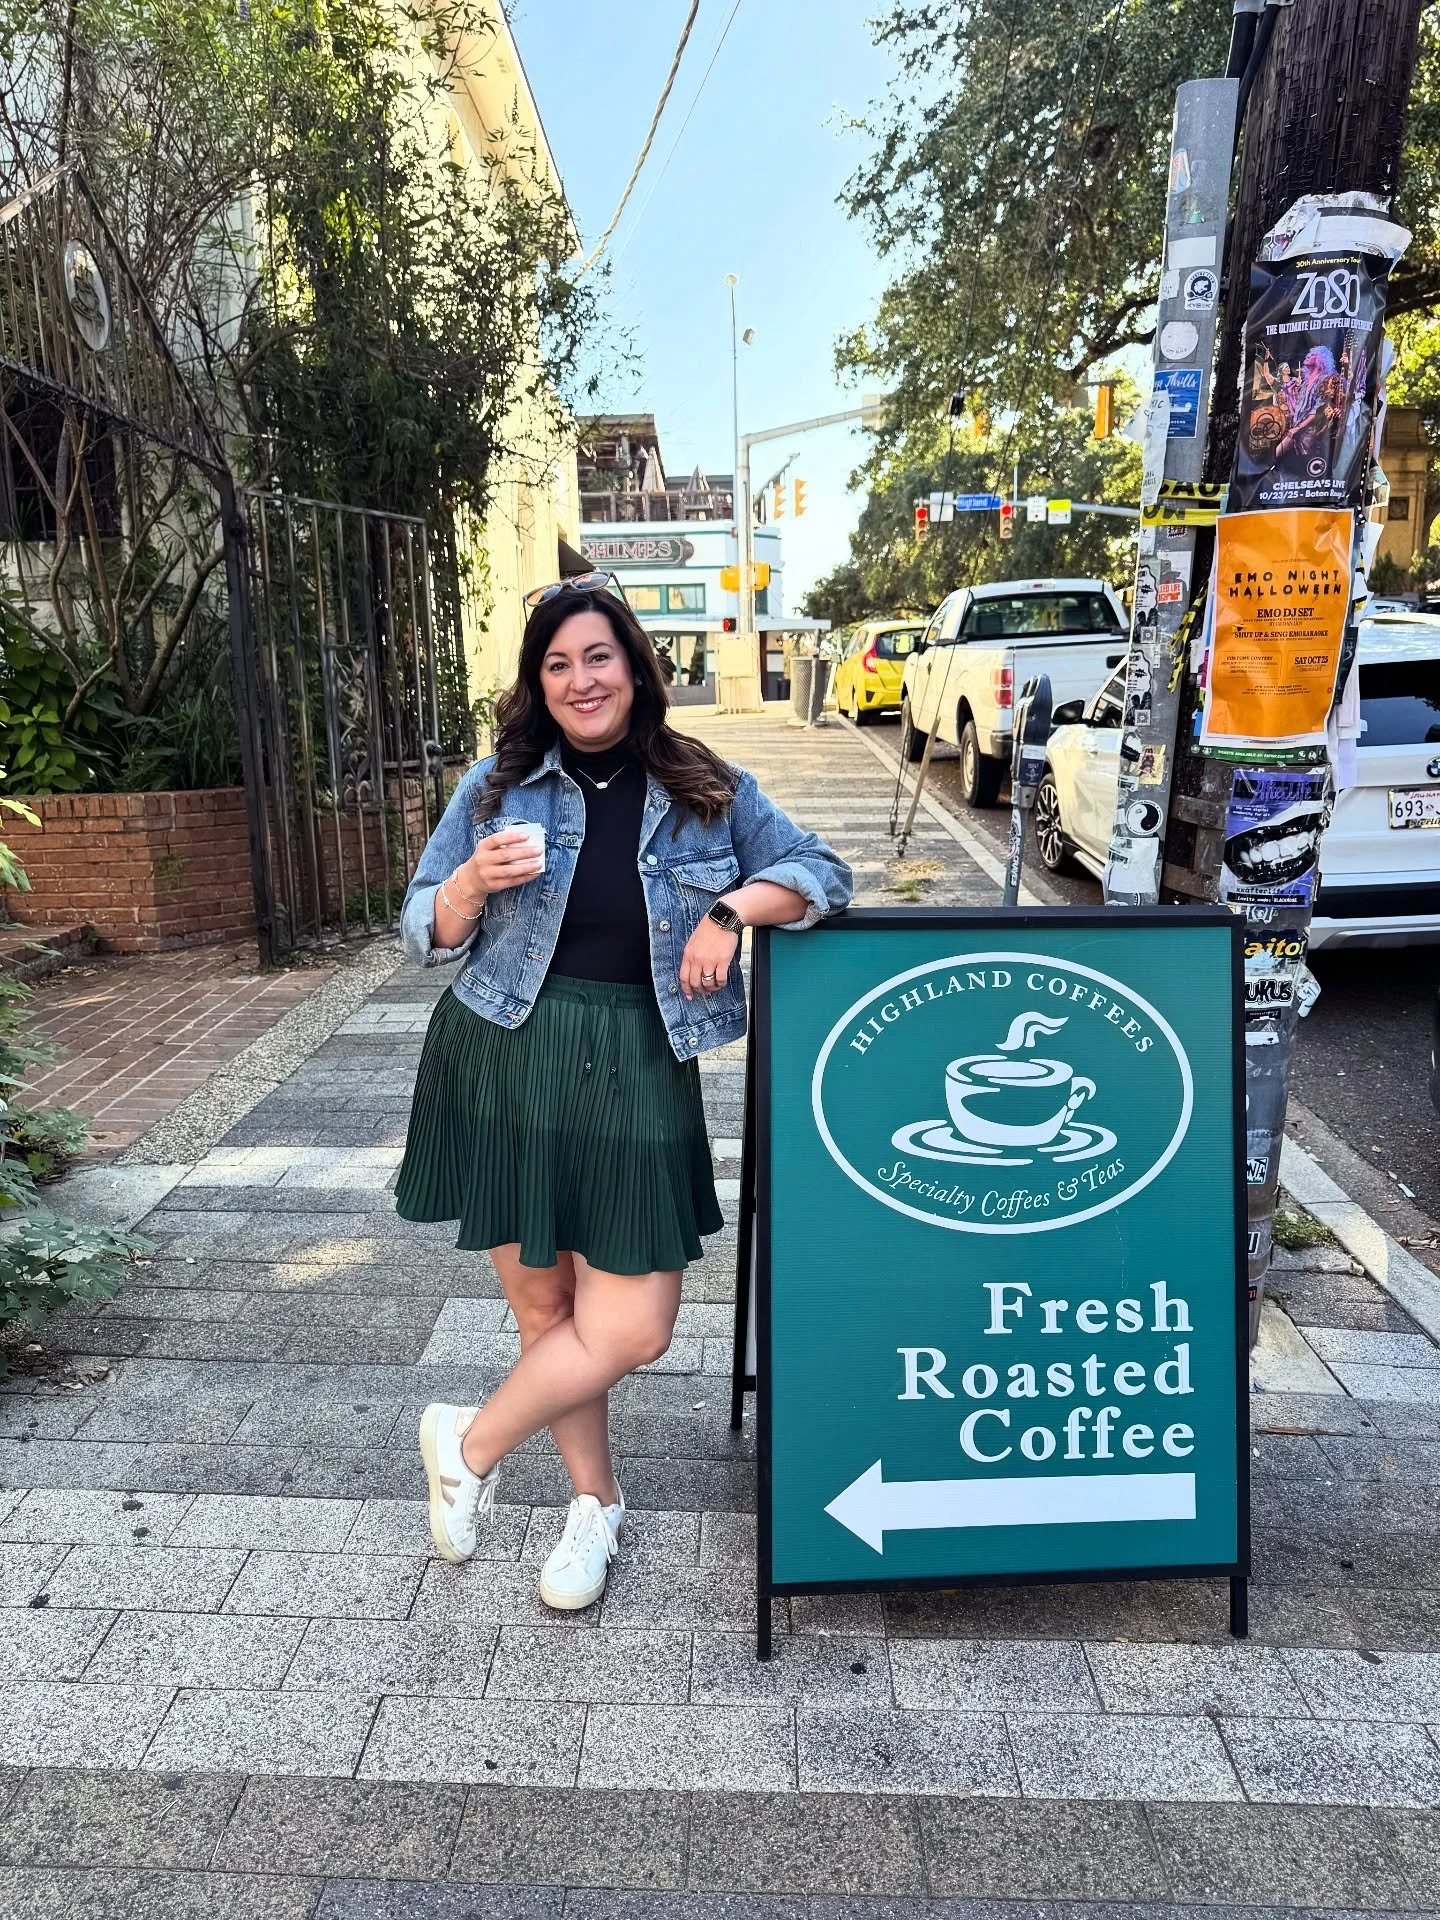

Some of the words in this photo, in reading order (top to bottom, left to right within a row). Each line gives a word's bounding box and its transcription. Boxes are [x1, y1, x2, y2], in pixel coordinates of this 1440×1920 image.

[1295, 260, 1311, 268] 30th
[1311, 257, 1351, 266] Anniversary
[1291, 269, 1360, 318] ZOSO
[1266, 324, 1278, 336] THE
[1278, 321, 1309, 334] ULTIMATE
[1309, 320, 1321, 331] LED
[1322, 318, 1351, 329] ZEPPELIN
[1165, 371, 1198, 389] Thrills
[1272, 479, 1331, 491] CHELSEA'S
[1259, 490, 1299, 500] 10/23/25
[1305, 489, 1329, 498] Baton
[1234, 571, 1273, 584] EMO
[1288, 570, 1339, 581] NIGHT
[1229, 583, 1341, 598] HALLOWEEN
[1256, 608, 1281, 618] EMO
[1283, 608, 1297, 617] DJ
[1298, 607, 1314, 617] SET
[1234, 631, 1254, 639] SHUT
[1294, 656, 1308, 665] SAT
[1307, 655, 1323, 664] OCT
[1322, 655, 1329, 664] 25
[1395, 800, 1424, 818] 693
[849, 970, 1013, 1055] HIGHLAND
[1026, 972, 1155, 1053] COFFEES
[877, 1160, 976, 1214] Specialty
[981, 1189, 1051, 1219] Coffees
[1057, 1181, 1079, 1201] &
[1080, 1157, 1126, 1193] Teas
[983, 1280, 1194, 1335] Fresh
[897, 1343, 1195, 1400] Roasted
[959, 1406, 1196, 1463] Coffee
